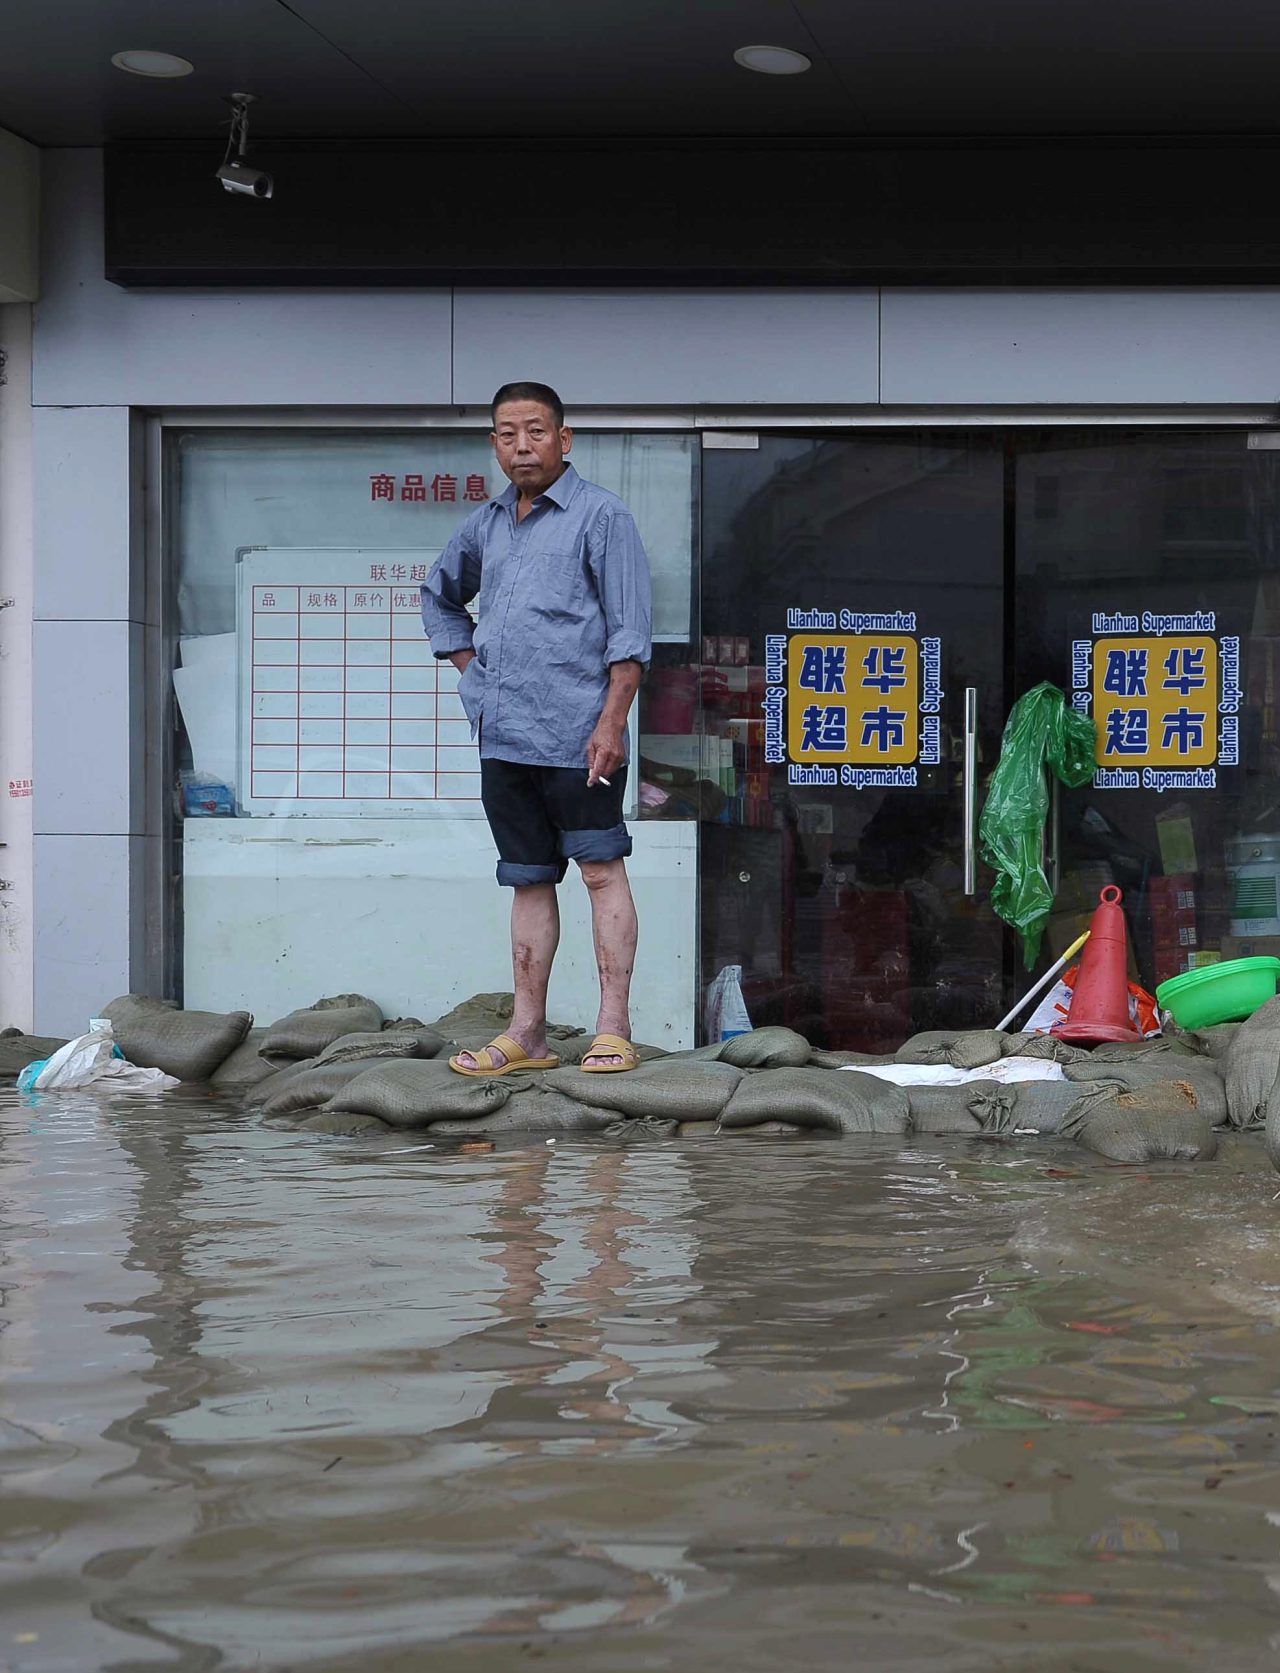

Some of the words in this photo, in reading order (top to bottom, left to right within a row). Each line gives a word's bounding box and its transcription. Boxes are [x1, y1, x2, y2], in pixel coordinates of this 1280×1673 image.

[369, 472, 491, 503] 商品信息
[262, 593, 276, 607] 品
[307, 592, 338, 607] 规格
[353, 592, 384, 607] 原价
[787, 607, 835, 630] Lianhua
[839, 608, 917, 635] Supermarket
[1091, 613, 1138, 634] Lianhua
[1141, 611, 1216, 637] Supermarket
[765, 634, 787, 683] Lianhua
[799, 646, 908, 695] 联华
[919, 637, 943, 714] Supermarket
[1072, 640, 1093, 688] Lianhua
[1103, 647, 1207, 698] 联华
[1218, 635, 1241, 714] Supermarket
[762, 686, 787, 764] Supermarket
[800, 704, 908, 753] 超市
[919, 716, 941, 765] Lianhua
[1104, 706, 1207, 755] 超市
[1218, 716, 1239, 766] Lianhua
[787, 764, 835, 786] Lianhua
[840, 765, 918, 792] Supermarket
[1092, 768, 1138, 790] Lianhua
[1142, 767, 1216, 793] Supermarket
